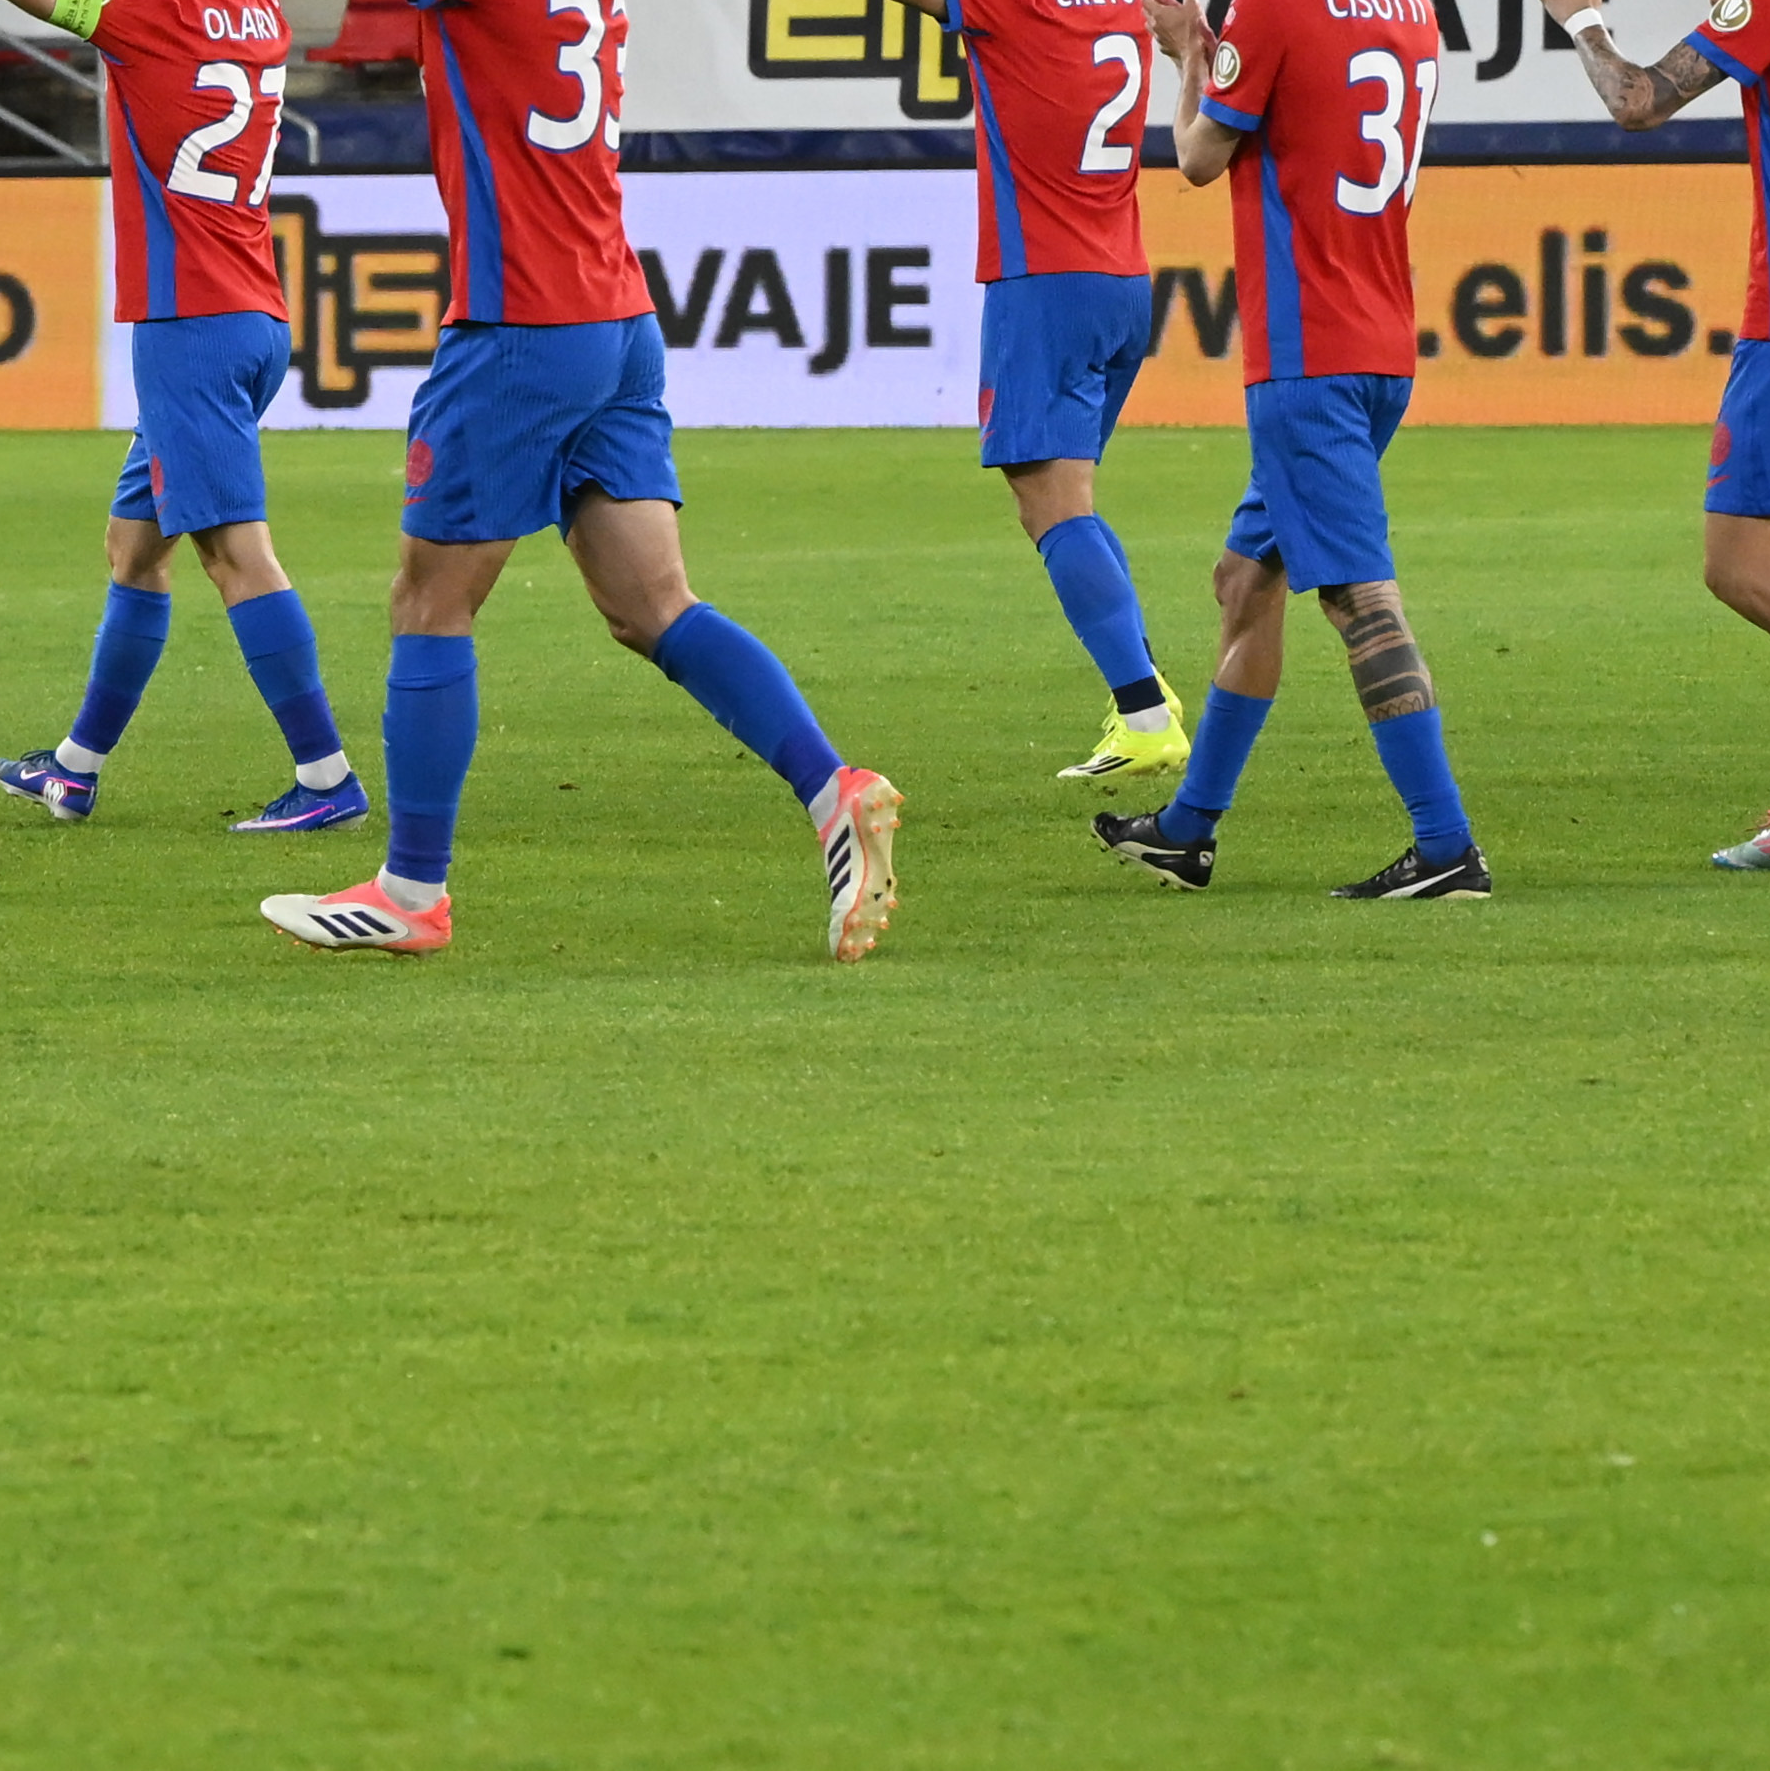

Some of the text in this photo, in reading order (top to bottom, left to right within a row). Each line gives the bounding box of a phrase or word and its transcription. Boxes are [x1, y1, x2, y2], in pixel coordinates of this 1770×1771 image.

[165, 59, 286, 208] 27
[1079, 33, 1142, 175] 2
[1335, 49, 1437, 216] 31
